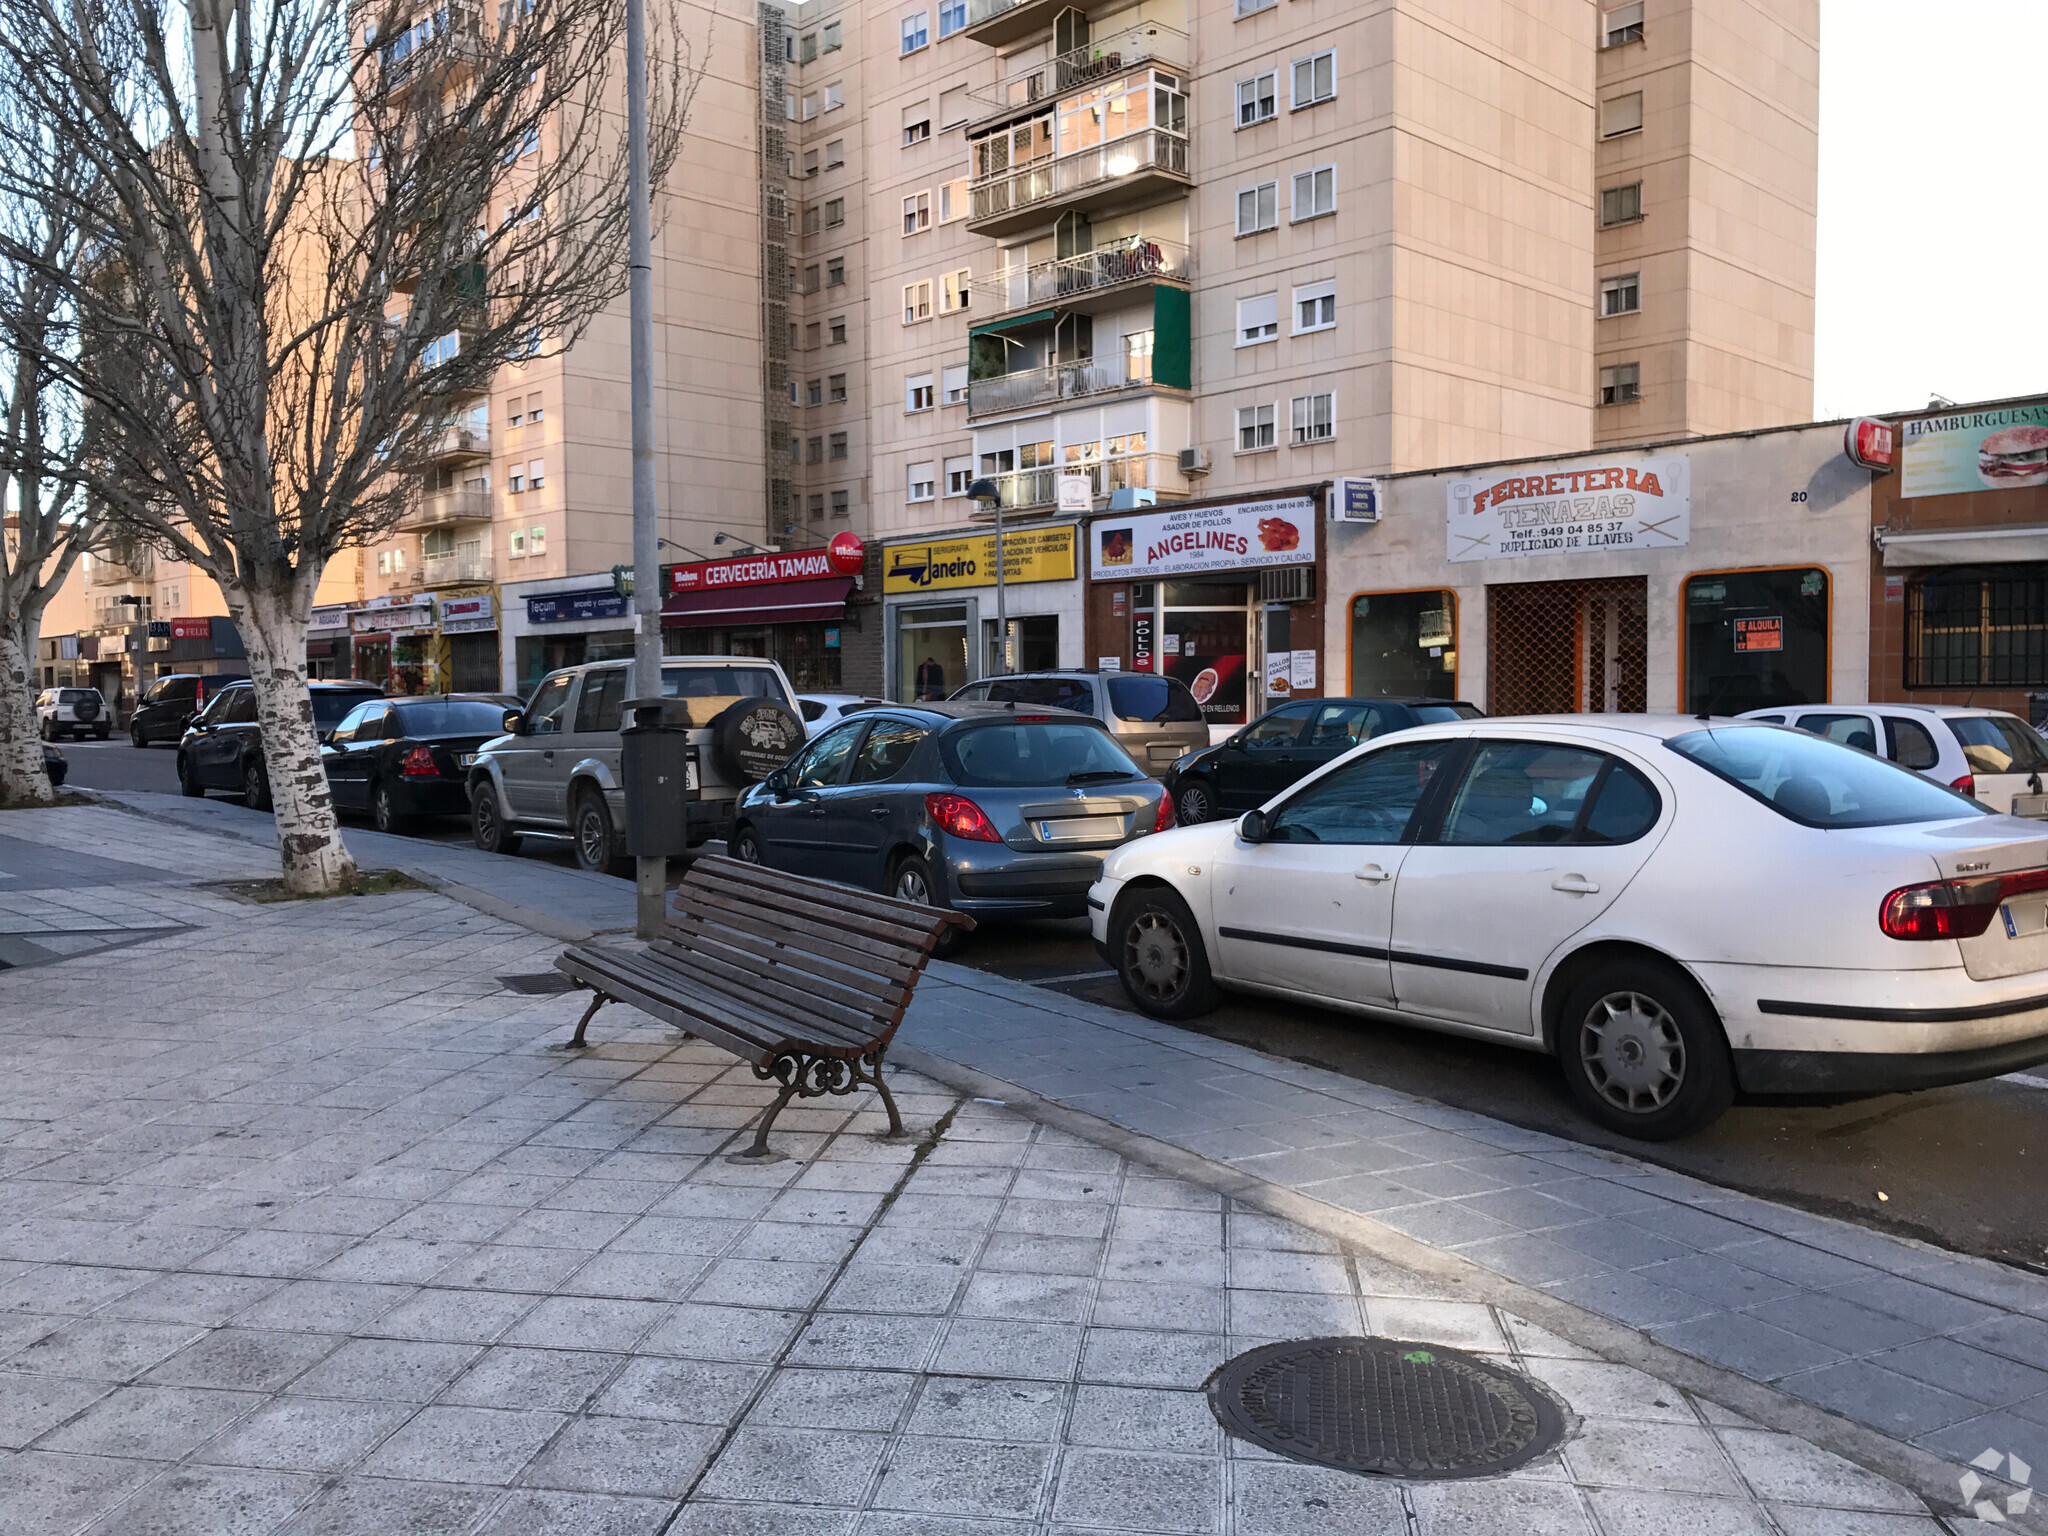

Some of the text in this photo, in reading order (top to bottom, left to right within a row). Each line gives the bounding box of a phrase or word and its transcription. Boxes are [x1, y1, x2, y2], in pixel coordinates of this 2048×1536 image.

[1473, 467, 1664, 516] FERRETERIA
[1169, 513, 1187, 522] AVES
[1194, 509, 1223, 519] HUEVOS
[1498, 494, 1636, 528] TENAZAS
[1162, 517, 1231, 532] ASADOR DE POLLOS
[1567, 526, 1583, 535] 04
[1587, 524, 1603, 533] 85
[1607, 522, 1623, 531] 37
[1028, 536, 1036, 545] DE
[1147, 531, 1248, 565] ANGELINES
[1500, 532, 1633, 553] DUPLICADO DE LLAVES
[1025, 546, 1033, 554] DE
[706, 555, 830, 585] CERVECERÍA TAMAYA
[920, 548, 976, 586] Janeiro
[1093, 567, 1130, 578] PRODUCTOS
[1131, 566, 1159, 575] FRESCOS
[1210, 559, 1236, 568] PROPIA
[1240, 555, 1273, 566] SERVICIO
[1281, 553, 1312, 562] CALIDAD
[371, 615, 389, 627] ARTE
[1736, 619, 1780, 632] SE ALQUILA
[1136, 620, 1150, 666] POLLOS
[1207, 705, 1214, 713] EN
[1214, 704, 1240, 713] RELLENOS
